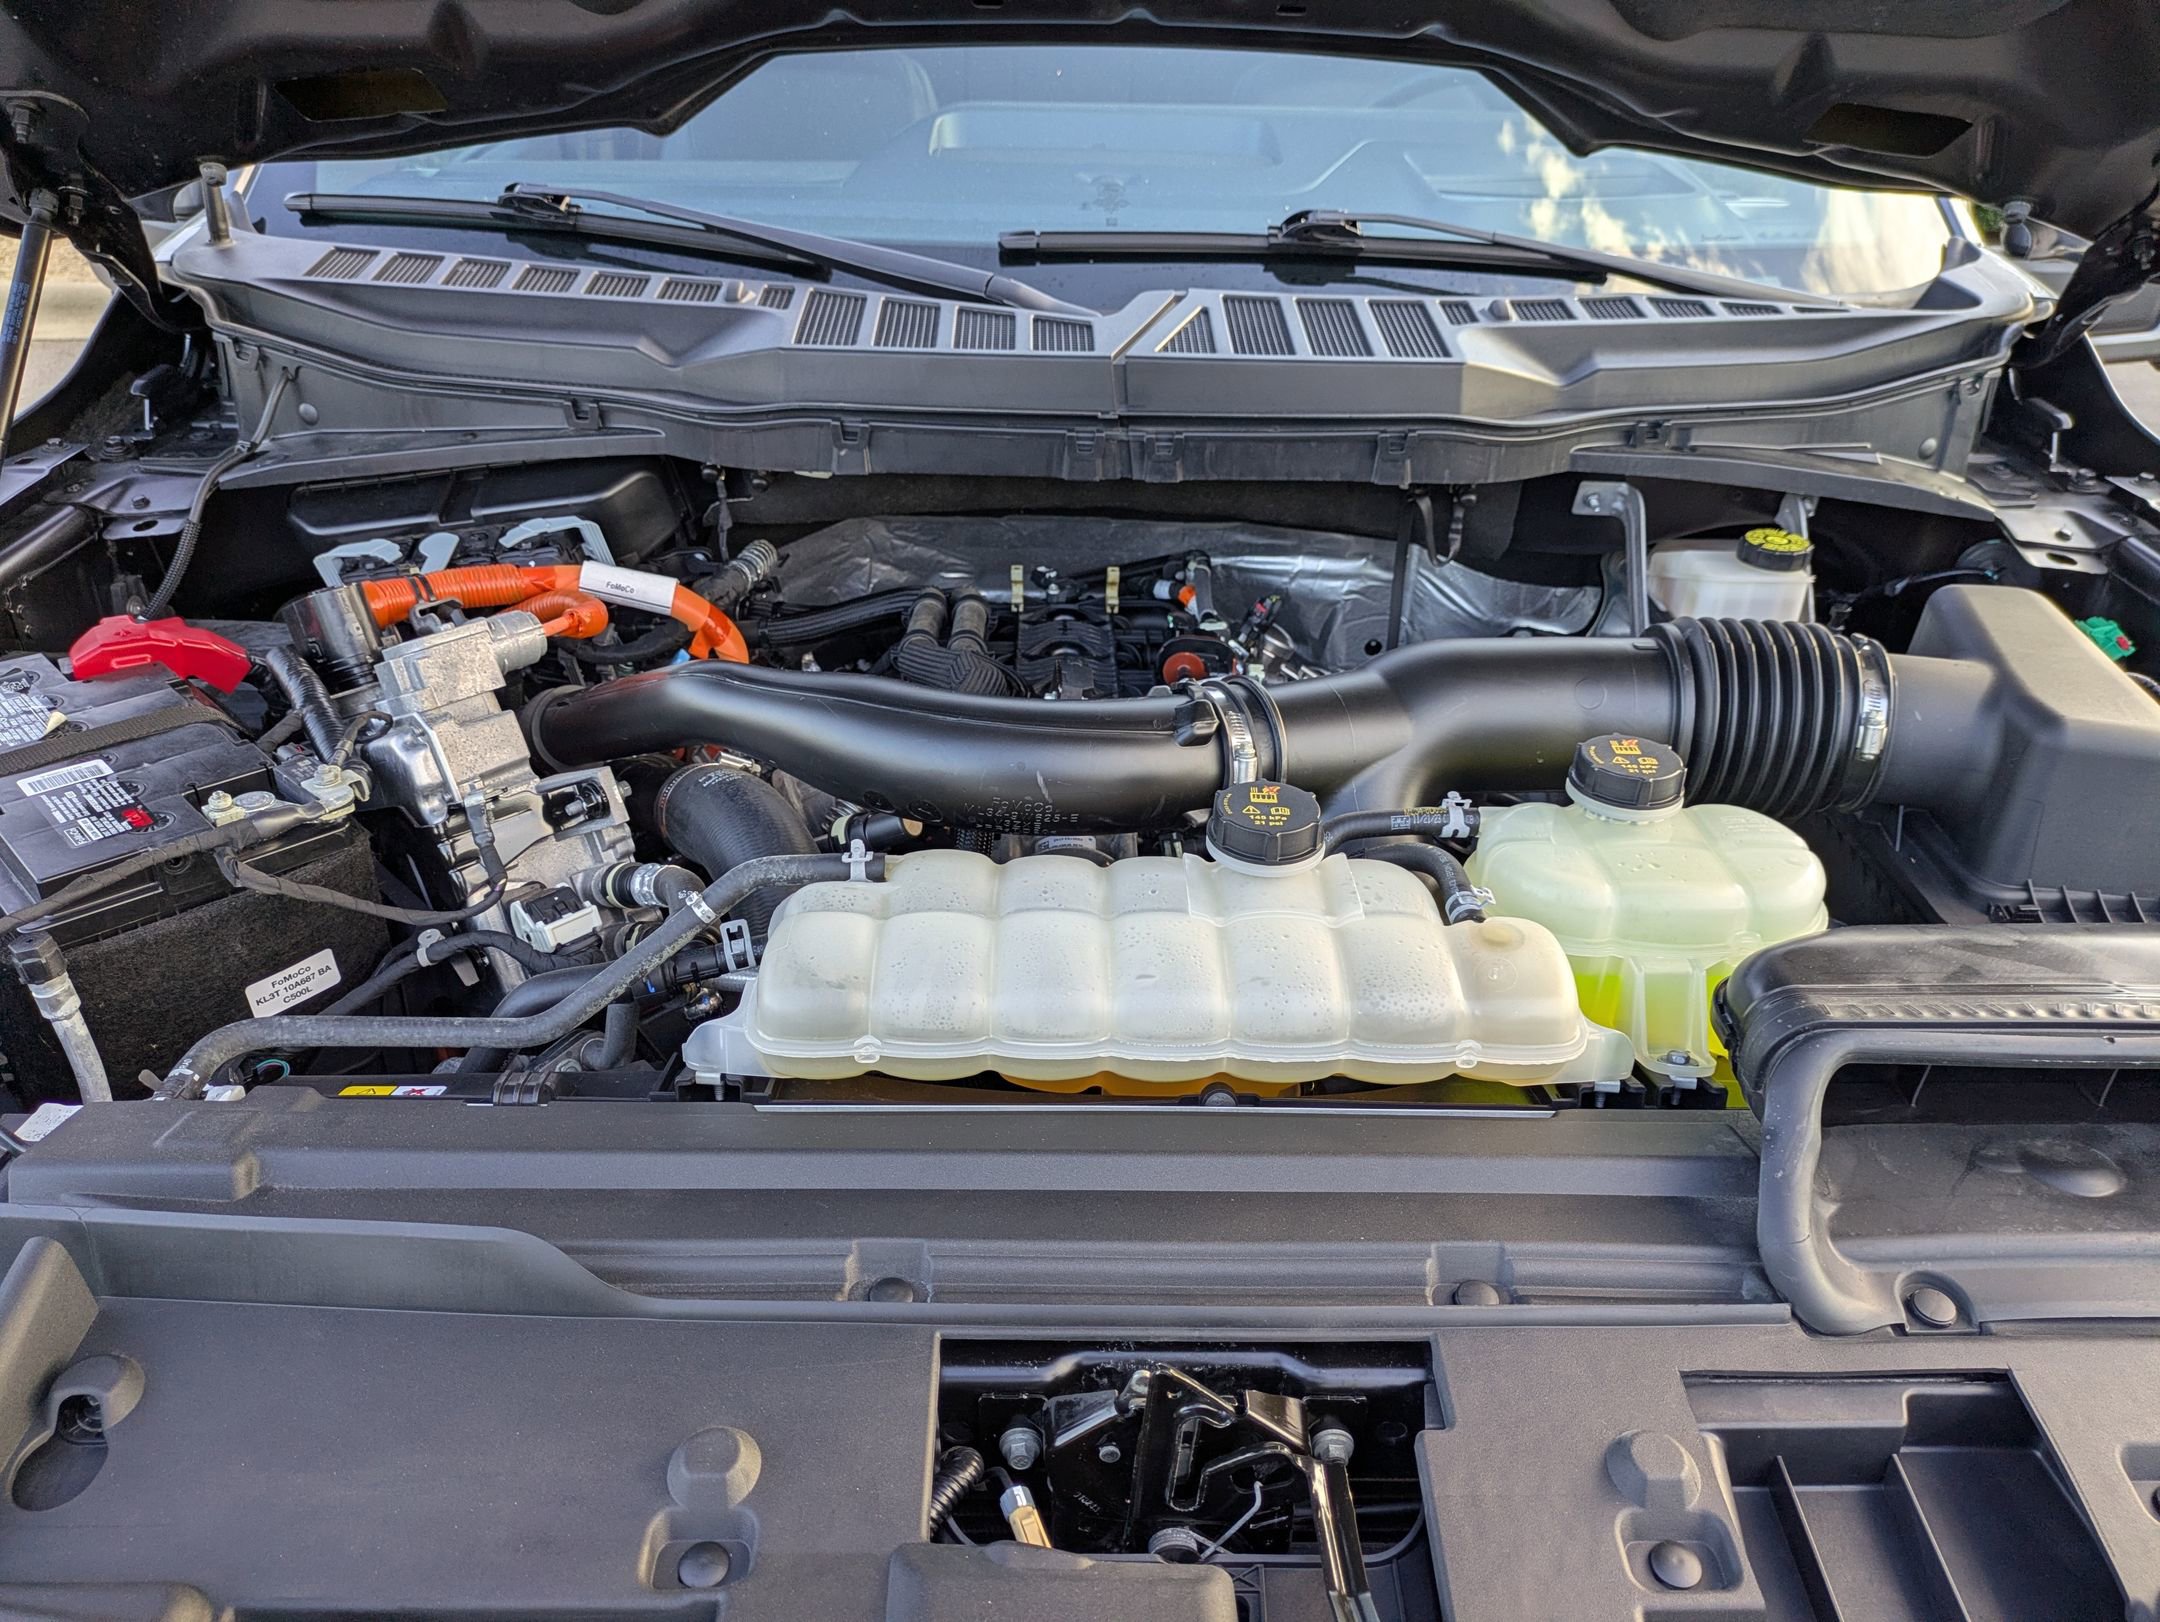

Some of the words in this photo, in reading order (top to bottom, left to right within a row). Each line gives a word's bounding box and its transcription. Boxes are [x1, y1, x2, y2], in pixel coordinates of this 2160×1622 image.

[606, 581, 635, 594] FoMoCo
[255, 990, 281, 1006] KL3T
[283, 973, 316, 993] 10A687
[317, 965, 332, 976] BA
[271, 966, 312, 988] FoMoCo
[283, 986, 313, 1004] C500L
